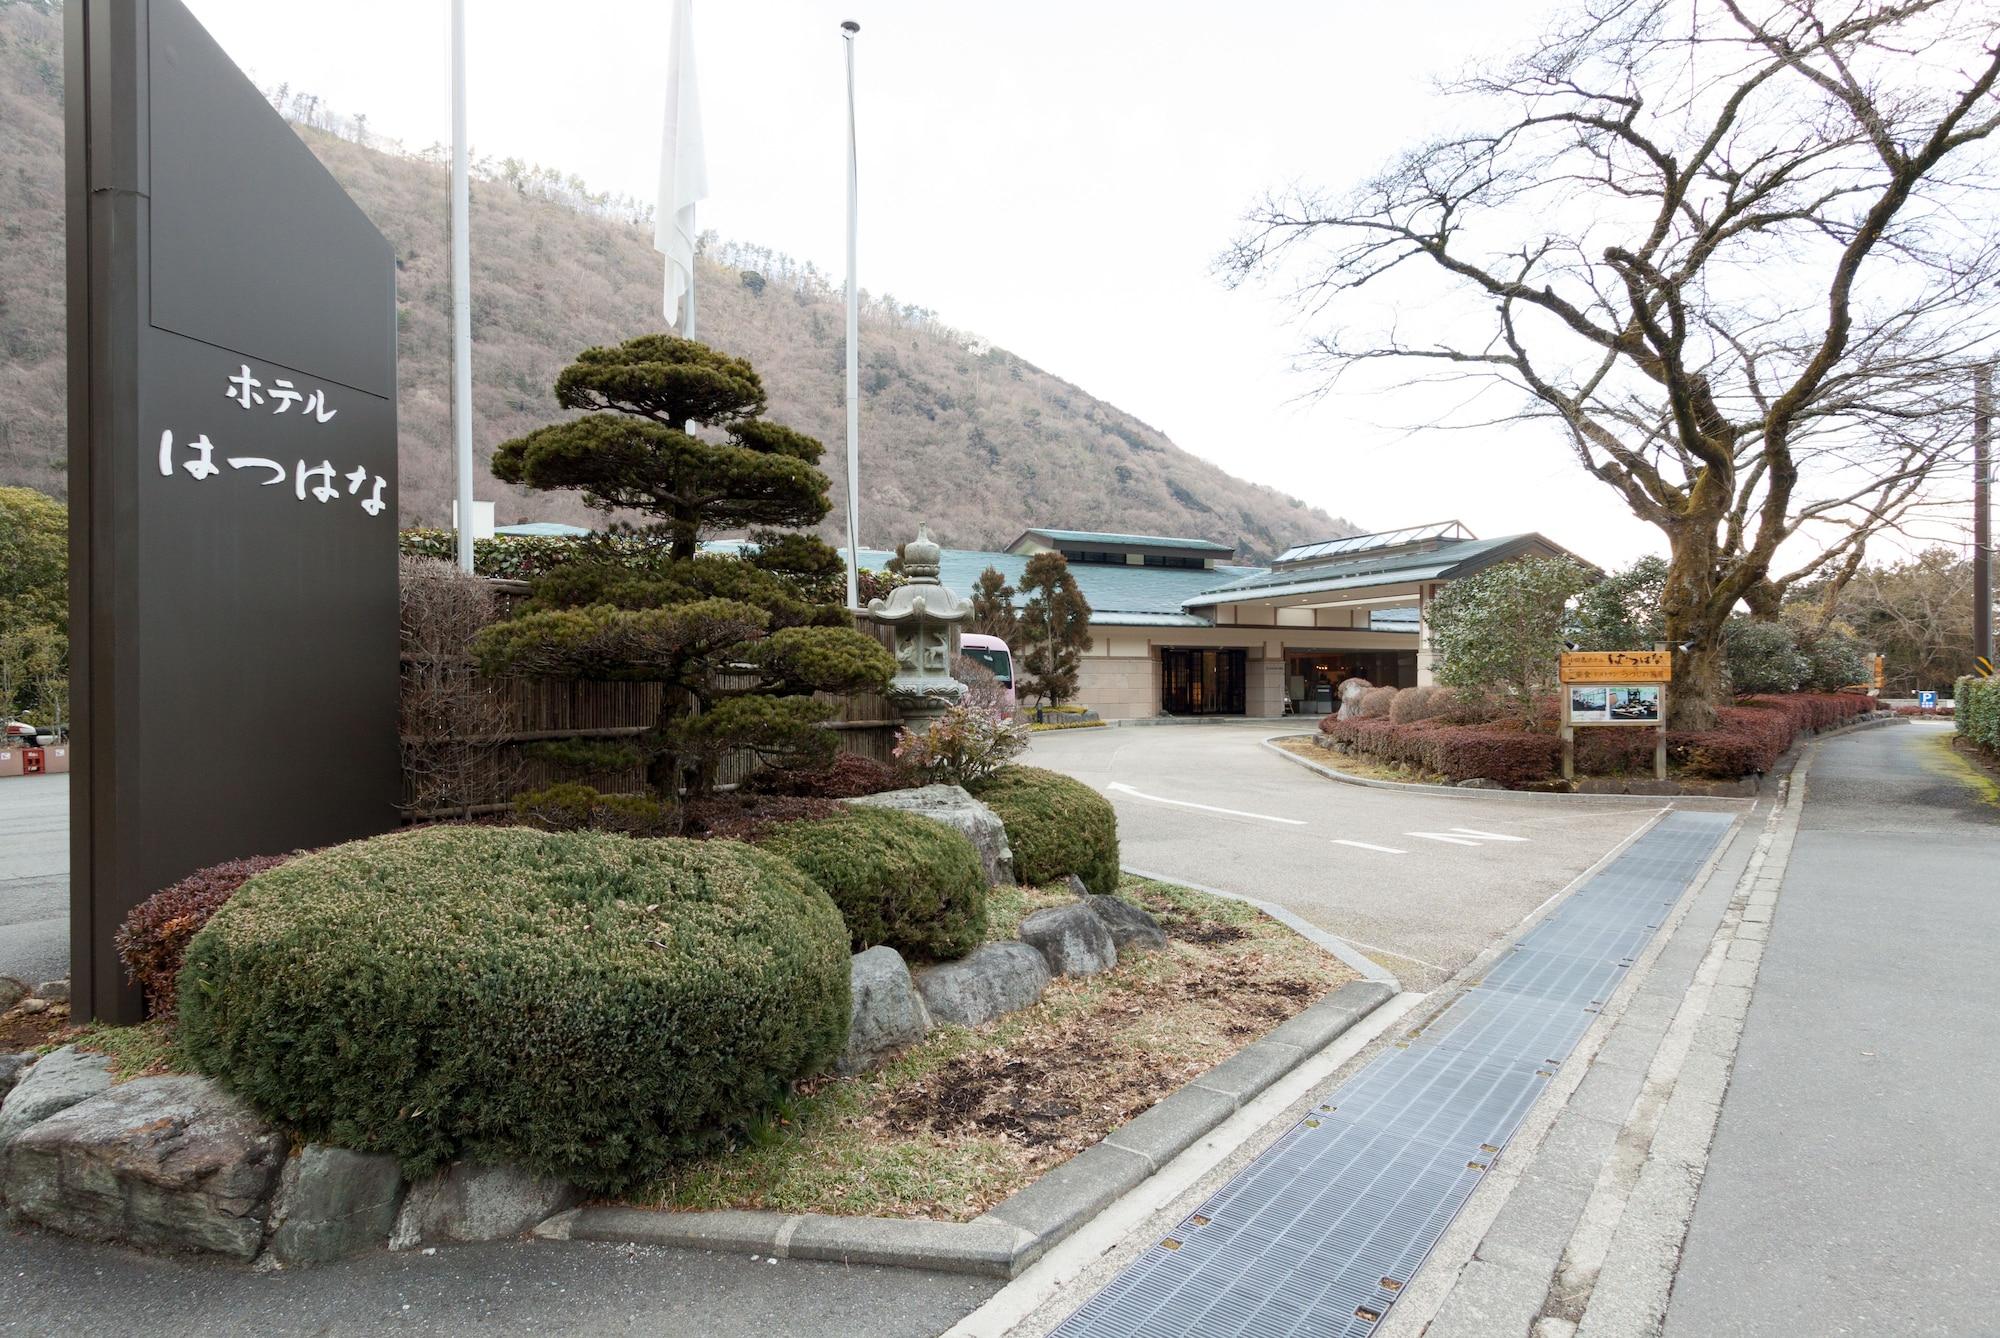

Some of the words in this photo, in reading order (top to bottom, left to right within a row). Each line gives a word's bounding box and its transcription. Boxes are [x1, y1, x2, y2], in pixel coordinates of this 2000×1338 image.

[225, 364, 338, 423] ホテル
[159, 429, 388, 516] はつはな
[1922, 693, 1932, 702] P
